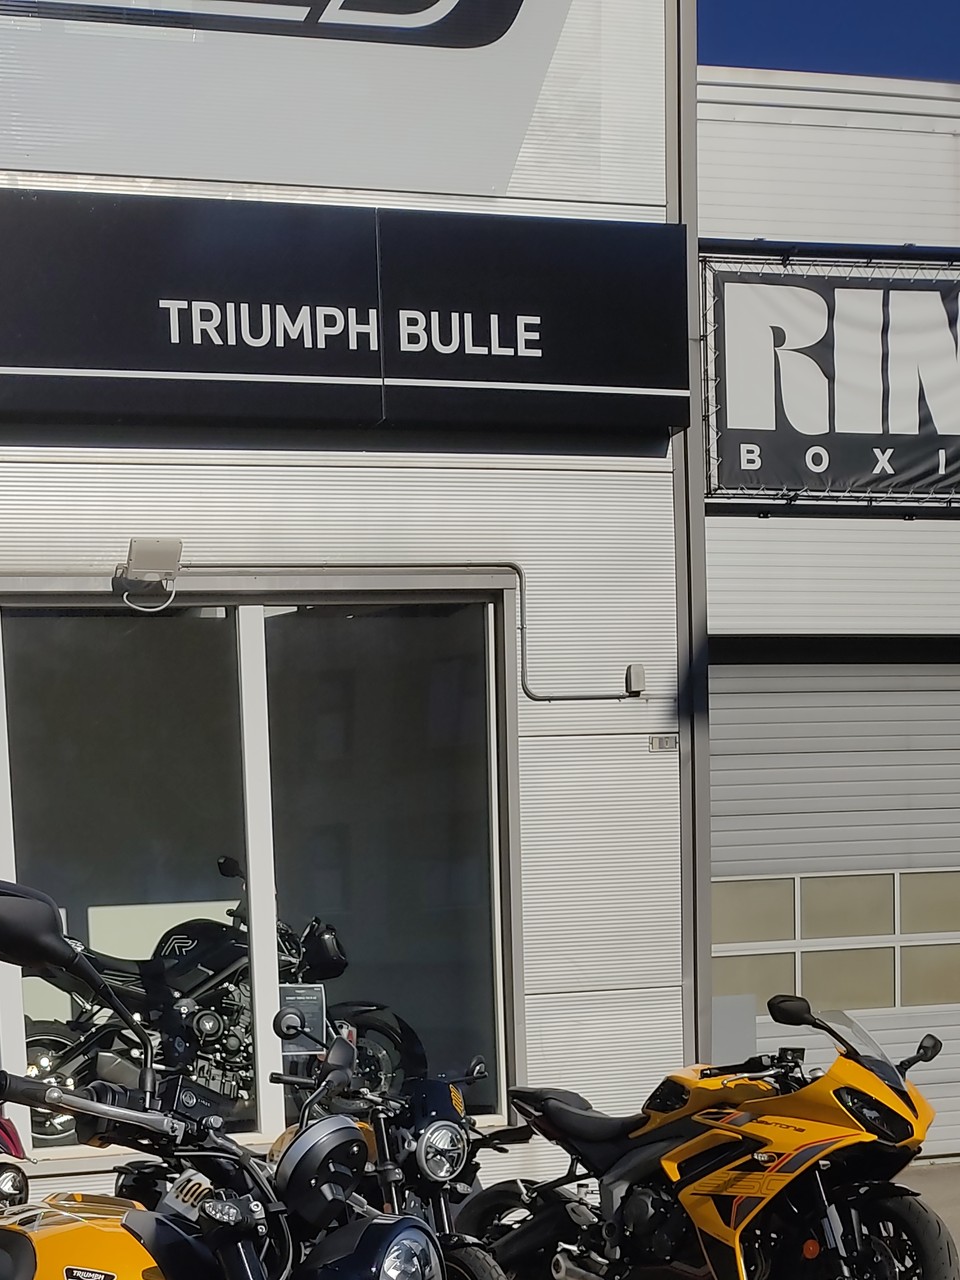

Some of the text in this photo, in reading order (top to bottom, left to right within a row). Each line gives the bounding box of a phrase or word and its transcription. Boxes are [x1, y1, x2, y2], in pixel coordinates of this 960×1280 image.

[158, 299, 543, 357] TRIUMPH BULLE
[739, 443, 947, 475] BOXI
[72, 1270, 105, 1280] TRIUMPH
